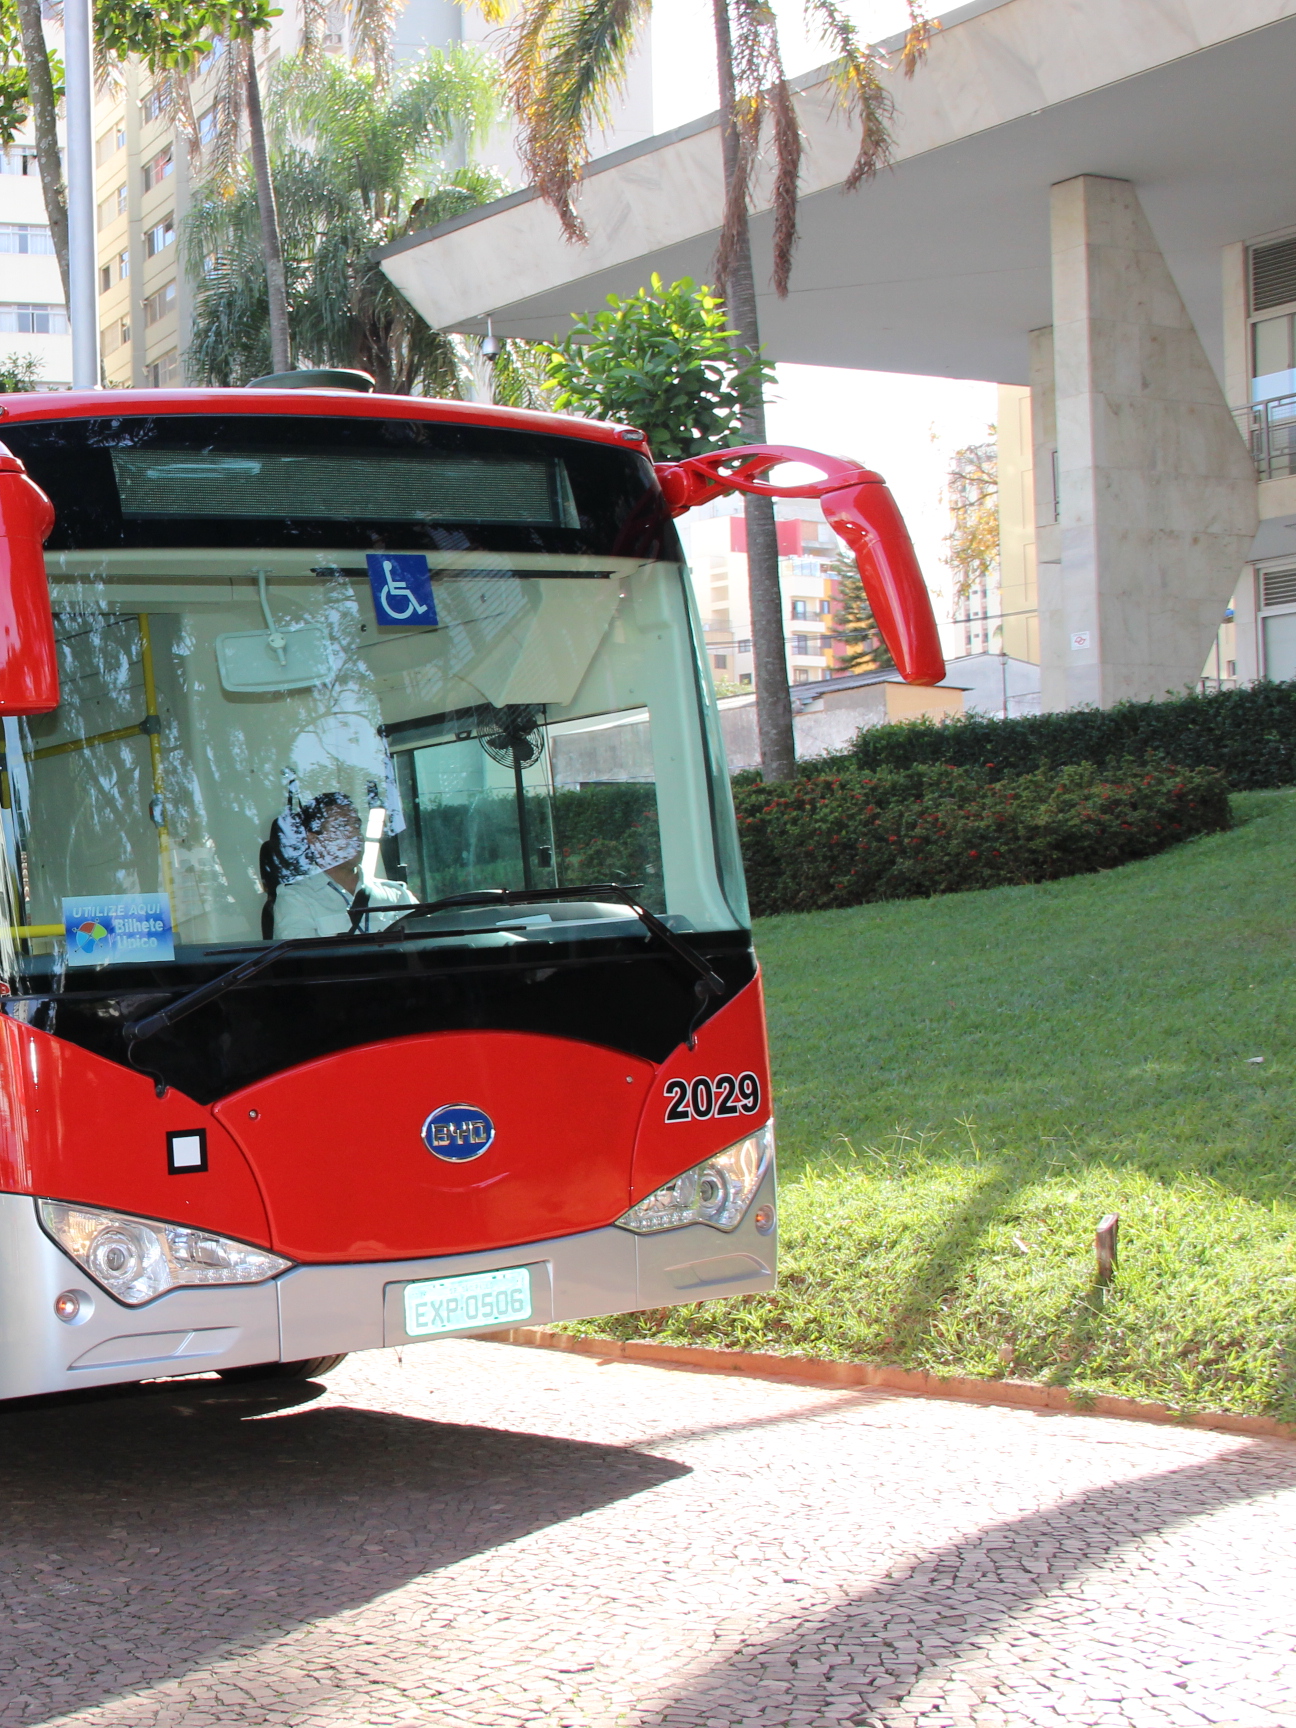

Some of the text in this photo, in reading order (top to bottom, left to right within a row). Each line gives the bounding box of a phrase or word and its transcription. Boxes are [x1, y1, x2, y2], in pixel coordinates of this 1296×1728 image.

[73, 903, 161, 918] UTILIZE AQUI
[115, 918, 164, 933] Bilhete
[664, 1071, 761, 1123] 2029
[431, 1120, 487, 1146] BYD
